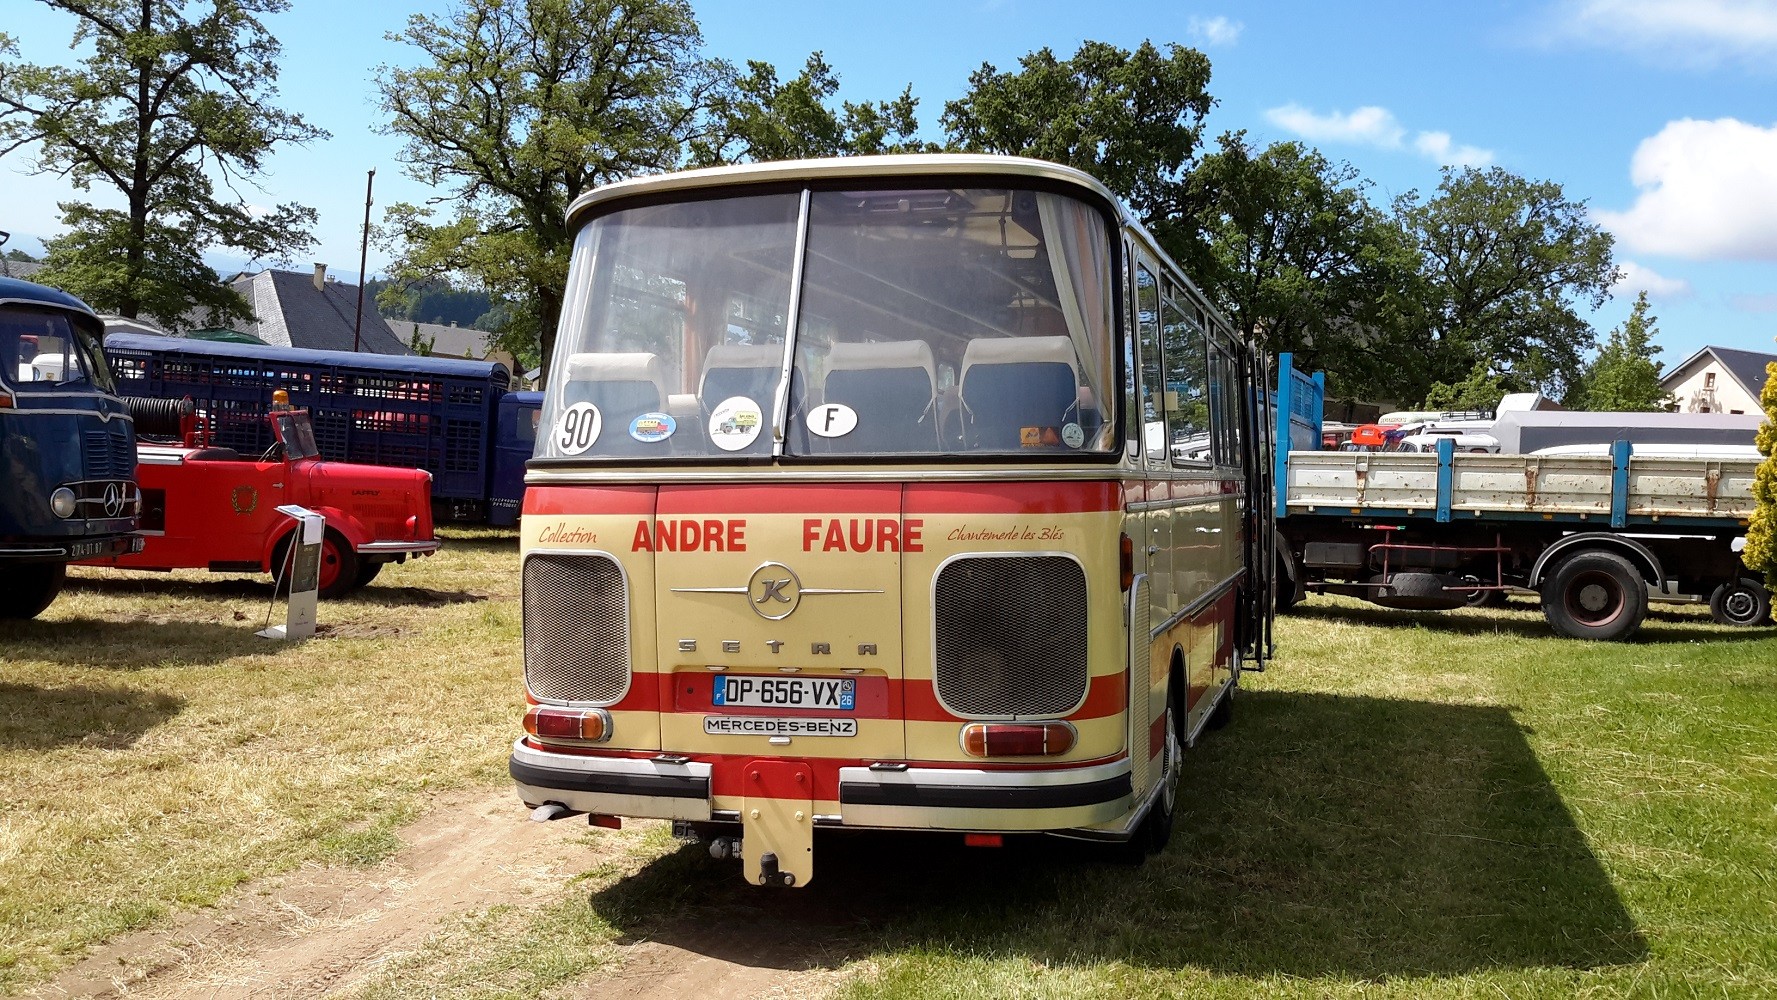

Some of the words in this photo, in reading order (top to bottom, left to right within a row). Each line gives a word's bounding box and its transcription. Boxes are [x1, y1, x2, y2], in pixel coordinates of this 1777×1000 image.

[561, 408, 595, 449] 90
[824, 407, 839, 432] F
[538, 522, 598, 544] Collection
[631, 520, 747, 552] ANDRE
[802, 518, 924, 553] FAURE
[1020, 525, 1036, 540] les
[1037, 525, 1065, 540] Blés
[678, 639, 878, 655] SETRA
[726, 679, 839, 706] DP-656-VX
[841, 694, 852, 706] 26
[707, 719, 853, 733] MERCEDES-BENZ
